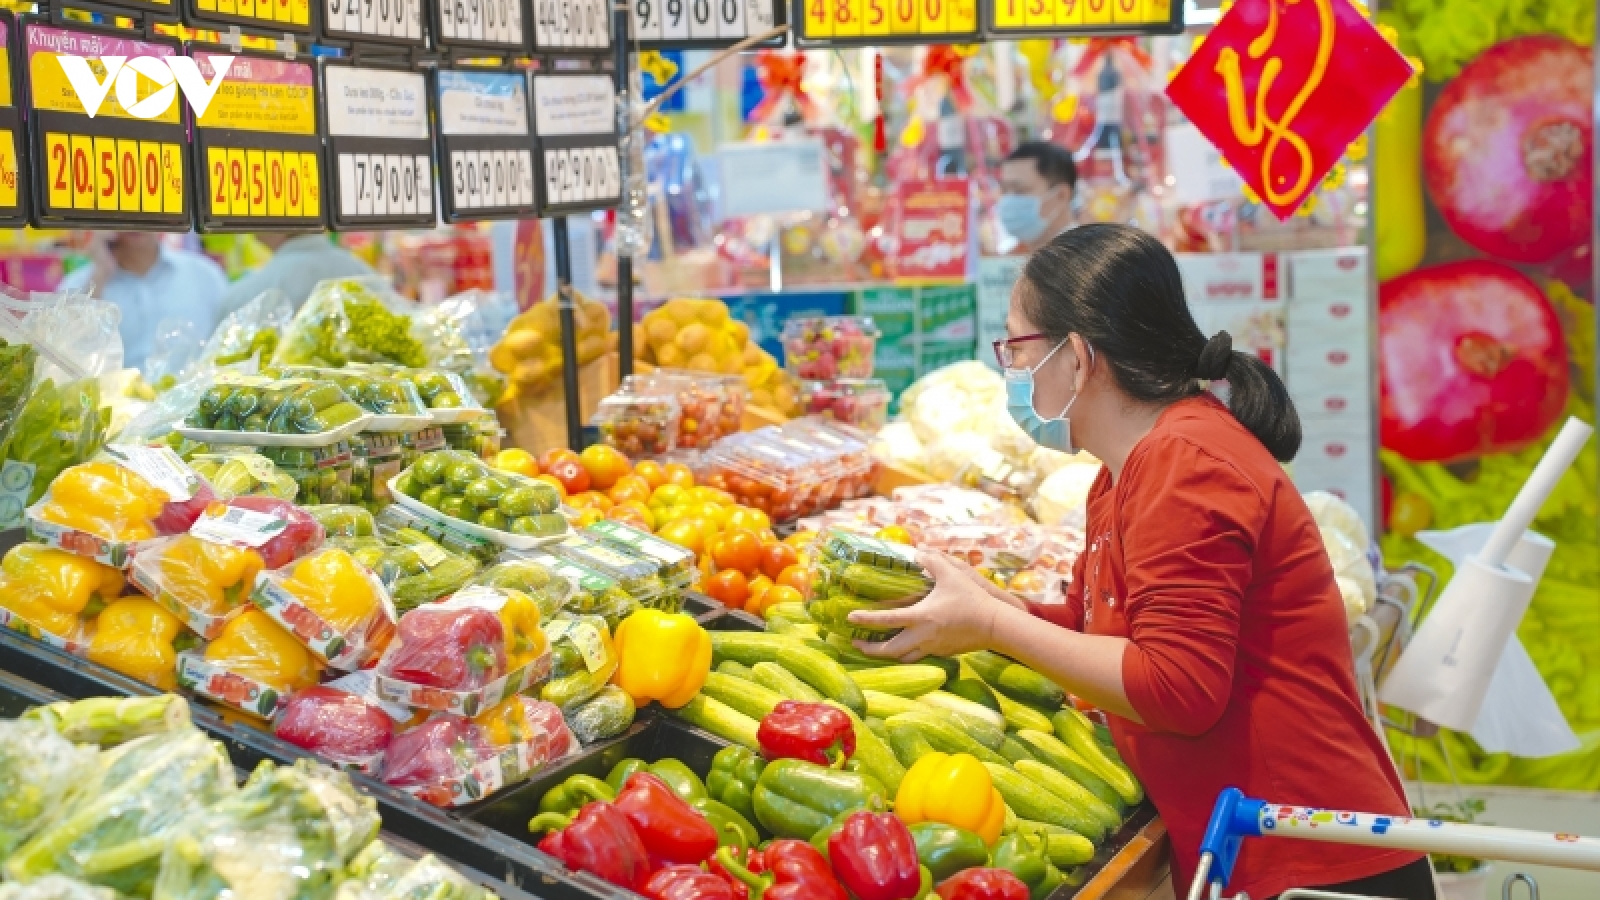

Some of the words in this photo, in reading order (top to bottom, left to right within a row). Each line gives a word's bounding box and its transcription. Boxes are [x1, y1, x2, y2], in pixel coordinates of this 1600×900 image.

[637, 0, 738, 29] 9.900
[53, 143, 159, 197] 20.500
[213, 158, 299, 208] 29.500
[355, 161, 413, 203] 7.900
